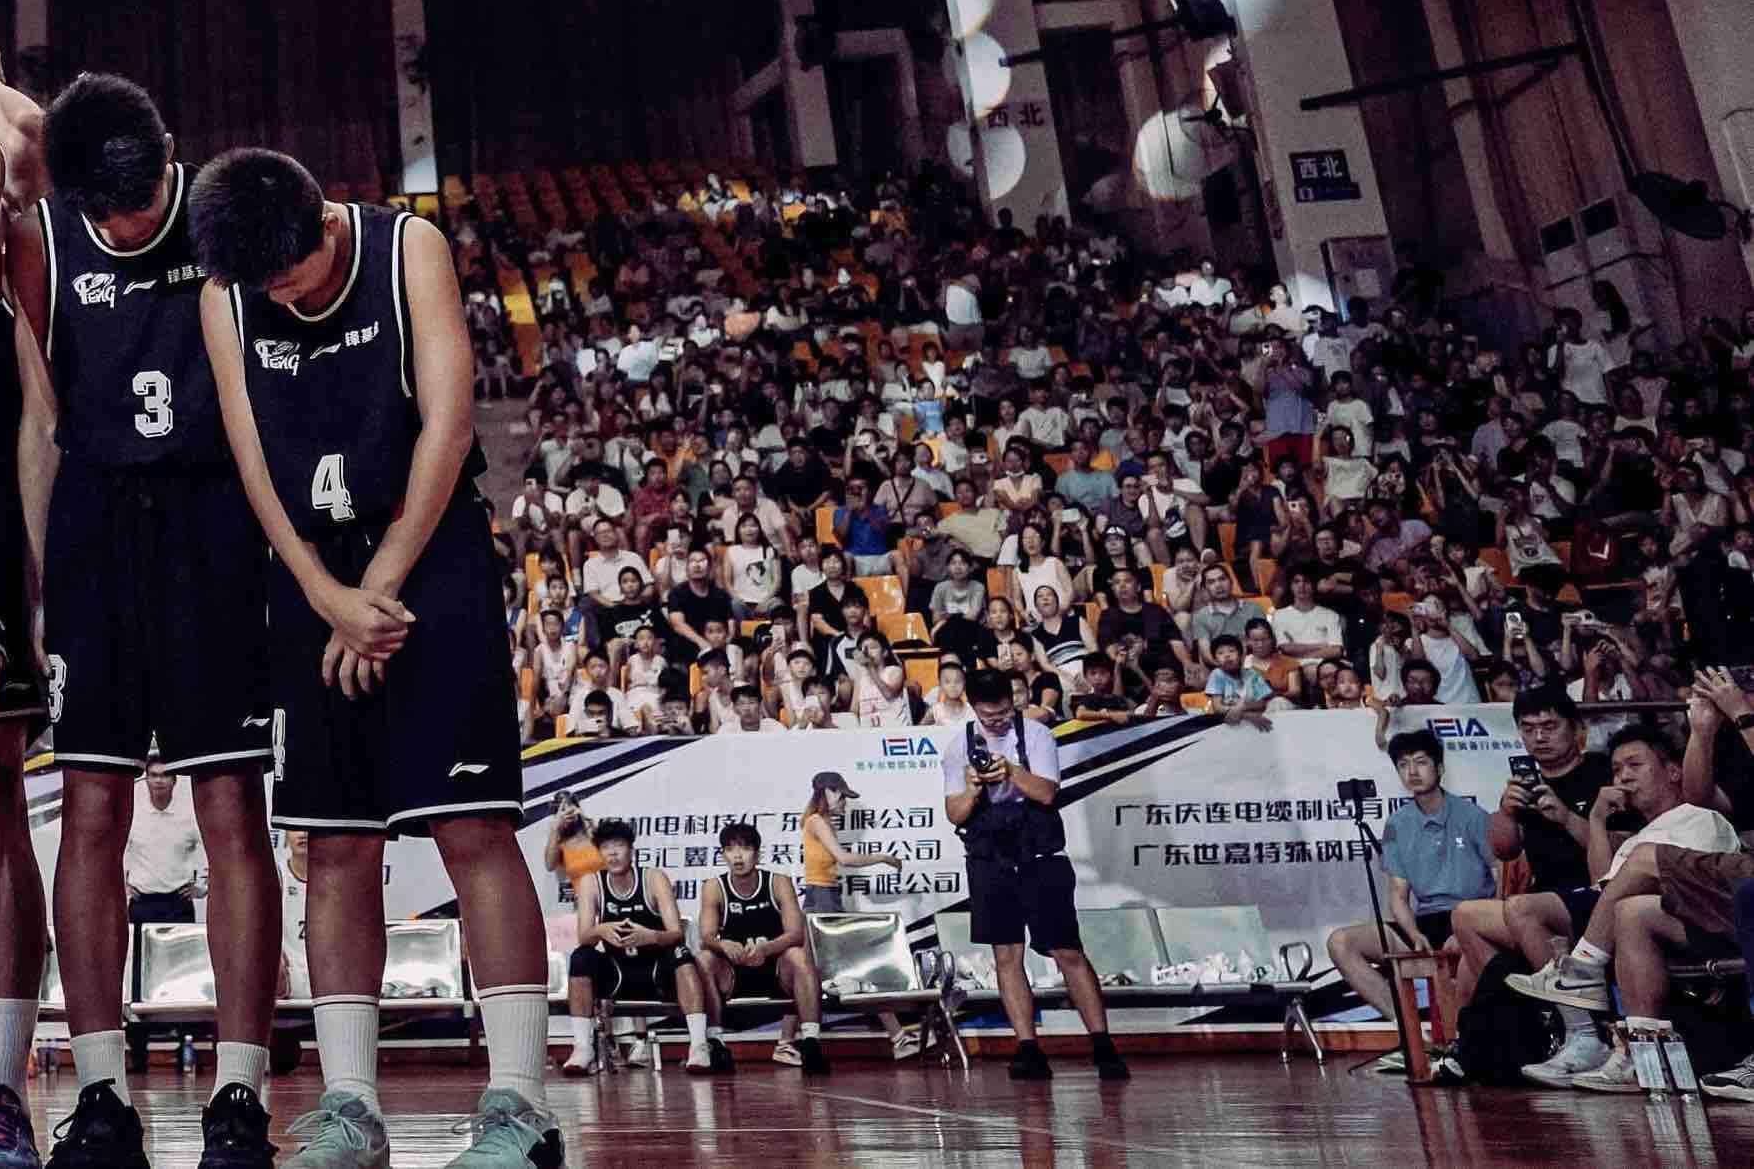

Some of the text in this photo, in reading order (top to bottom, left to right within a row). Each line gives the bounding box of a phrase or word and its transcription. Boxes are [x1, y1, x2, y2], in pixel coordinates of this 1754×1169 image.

[1295, 157, 1343, 180] 西北
[131, 370, 174, 438] 3
[311, 453, 356, 522] 4
